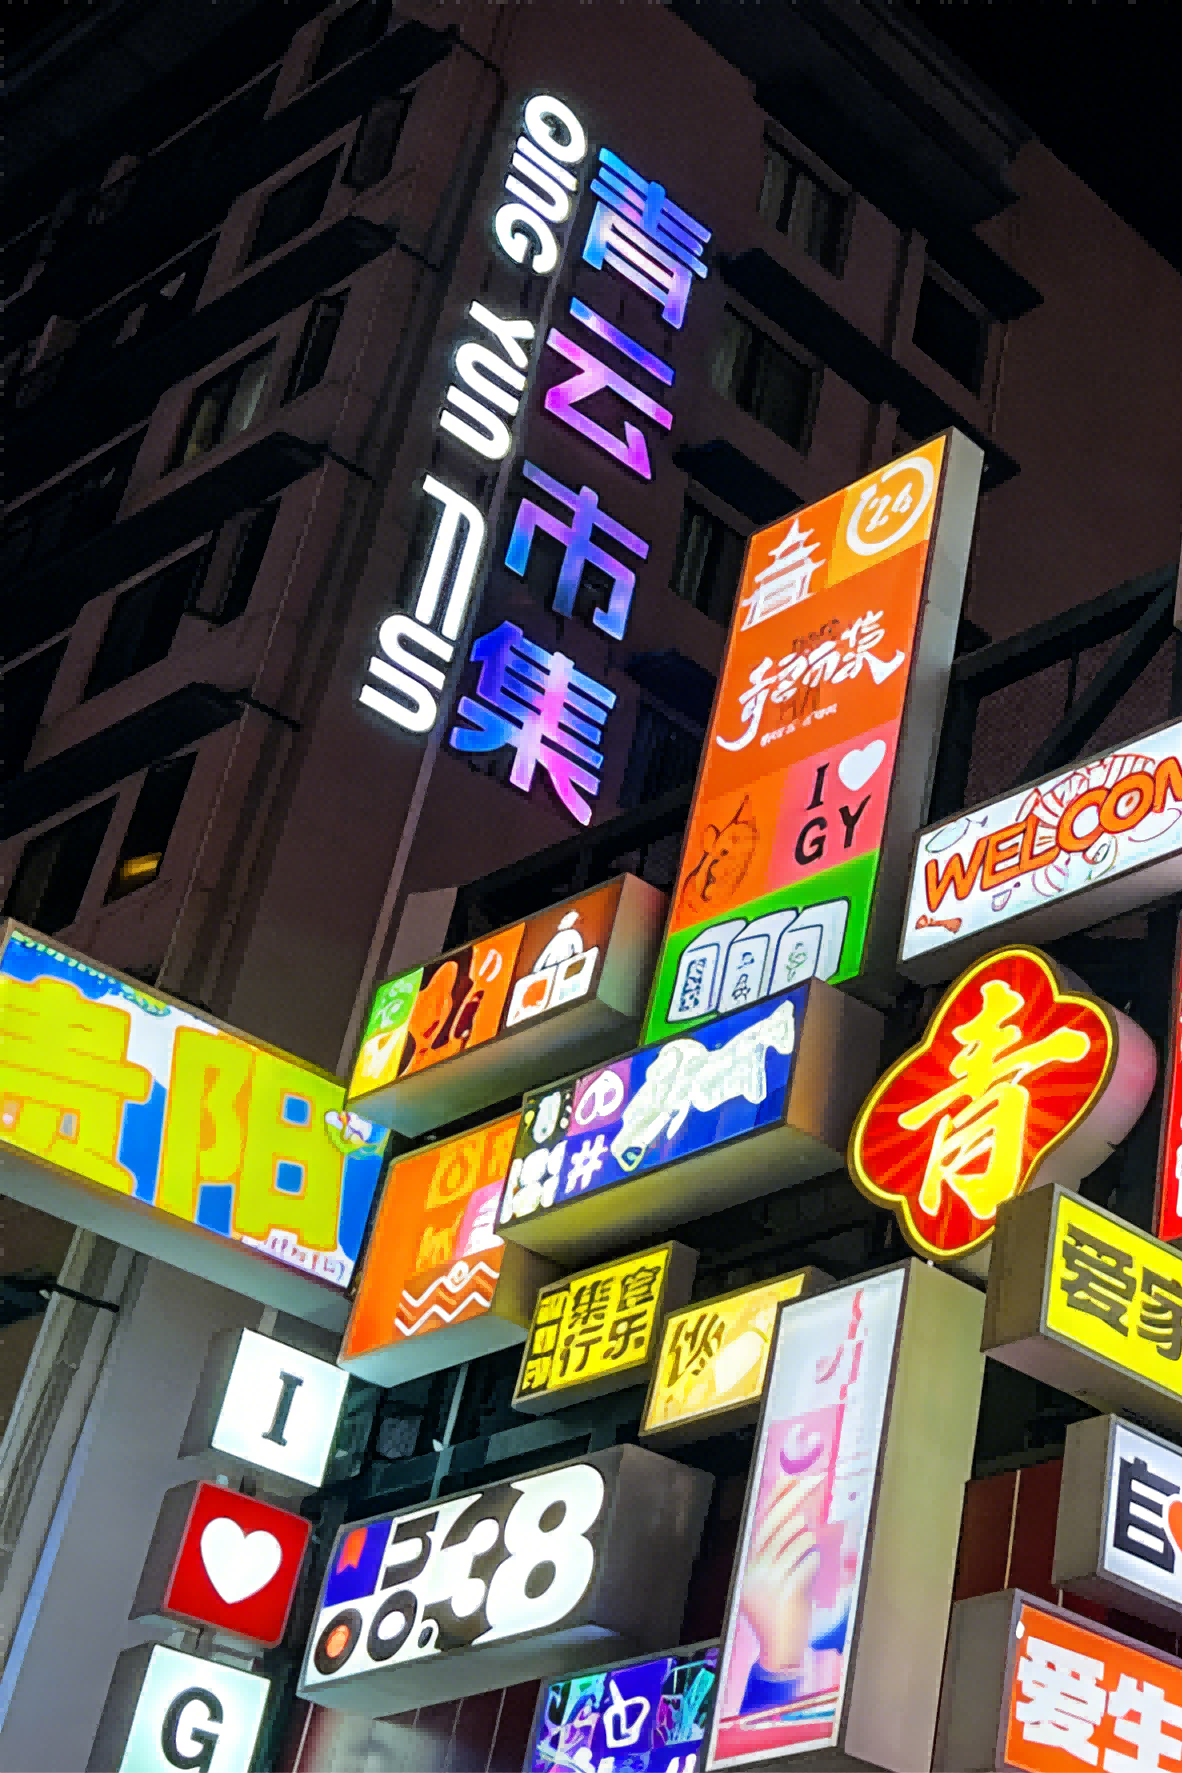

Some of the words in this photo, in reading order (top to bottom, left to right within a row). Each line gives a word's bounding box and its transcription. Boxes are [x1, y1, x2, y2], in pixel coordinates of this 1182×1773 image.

[494, 93, 588, 275] QING
[438, 300, 536, 461] YUN
[449, 147, 713, 827] 青云市集
[795, 794, 873, 867] GY
[898, 980, 1091, 1219] 青
[559, 1309, 648, 1378] 行乐
[262, 1370, 304, 1447] I
[160, 1686, 225, 1772] G
